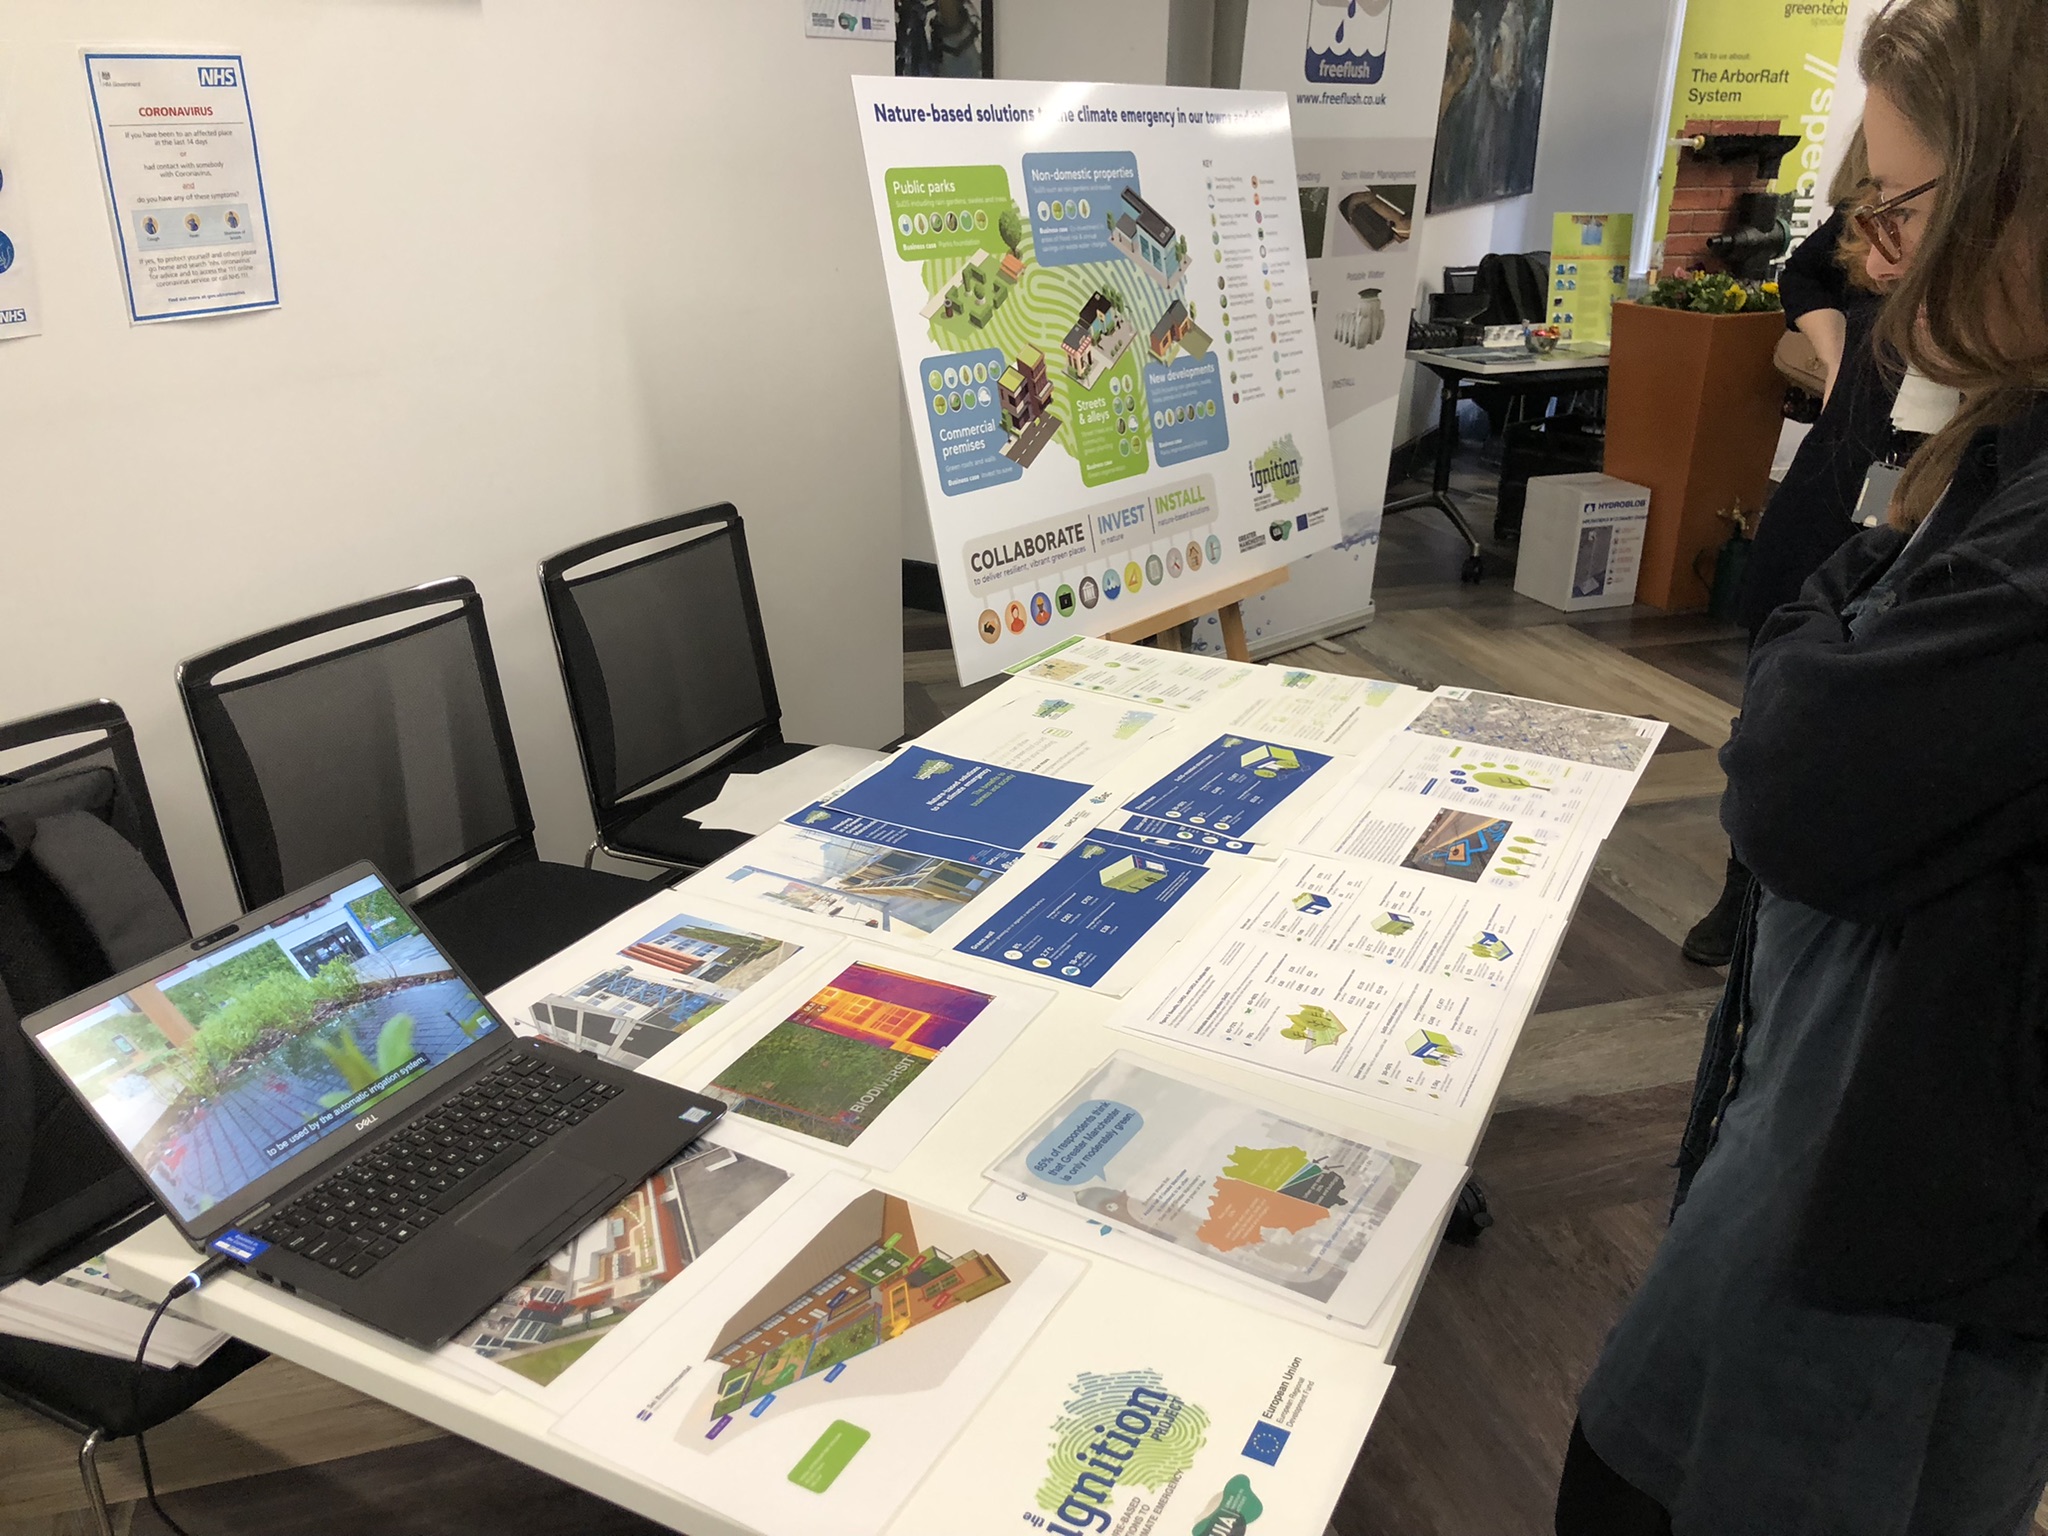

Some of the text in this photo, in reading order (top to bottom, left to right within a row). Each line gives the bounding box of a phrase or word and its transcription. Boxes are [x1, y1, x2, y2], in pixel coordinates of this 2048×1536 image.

[1784, 2, 1848, 18] green-tech
[1693, 52, 1709, 60] Talk
[1710, 52, 1717, 60] to
[201, 69, 234, 85] NHS
[1319, 60, 1370, 79] freeflush
[1691, 69, 1789, 84] The ArborRaft
[1296, 92, 1386, 105] www.freeflush.co.uk
[1688, 88, 1742, 104] System
[139, 107, 213, 116] CORONAVIRUS
[874, 103, 973, 122] Nature-based
[977, 104, 1035, 122] solutions
[1077, 106, 1118, 123] climate
[1120, 108, 1176, 128] emergency
[1178, 109, 1187, 124] in
[1189, 111, 1203, 124] our
[195, 138, 208, 146] days
[196, 161, 224, 169] somebody
[1202, 160, 1213, 168] KEY
[1031, 166, 1134, 181] Non-domestic properties
[211, 192, 239, 200] symptoms?
[893, 180, 955, 196] Public parks
[165, 255, 186, 263] protect
[188, 253, 210, 262] yourself
[241, 249, 257, 257] please
[156, 278, 190, 287] coronavirus
[0, 310, 24, 323] NHS
[1149, 364, 1215, 385] New developments
[1076, 398, 1106, 411] Streets
[1079, 411, 1109, 425] & alleys
[940, 419, 996, 441] Commercial
[943, 439, 986, 460] premises
[1250, 458, 1299, 493] ignition
[1155, 486, 1206, 515] INSTALL
[1098, 504, 1145, 534] INVEST
[1158, 505, 1210, 527] nature-based solutions
[1101, 533, 1124, 545] in nature
[971, 523, 1085, 573] COLLABORATE
[982, 571, 1002, 584] deliver
[1003, 563, 1029, 578] resilient,
[1030, 556, 1050, 569] vibrant
[1052, 551, 1068, 564] green
[1069, 546, 1086, 560] places
[266, 1056, 428, 1157] to be used by the automatic irrigation system.
[355, 1114, 379, 1131] DELL
[1051, 1149, 1061, 1157] of
[1058, 1115, 1096, 1150] respondents
[1092, 1101, 1111, 1116] think
[1048, 1108, 1120, 1176] that Greater Manchester
[1070, 1161, 1086, 1175] only
[1082, 1129, 1118, 1162] moderately
[1114, 1112, 1136, 1130] green.
[1262, 1356, 1302, 1420] European Union
[1276, 1377, 1305, 1424] European Regional
[1286, 1380, 1315, 1428] Development Fund
[1151, 1396, 1185, 1442] PROJECT
[1153, 1468, 1184, 1515] EMERGENCY
[1138, 1503, 1150, 1517] TO
[1023, 1511, 1045, 1527] the
